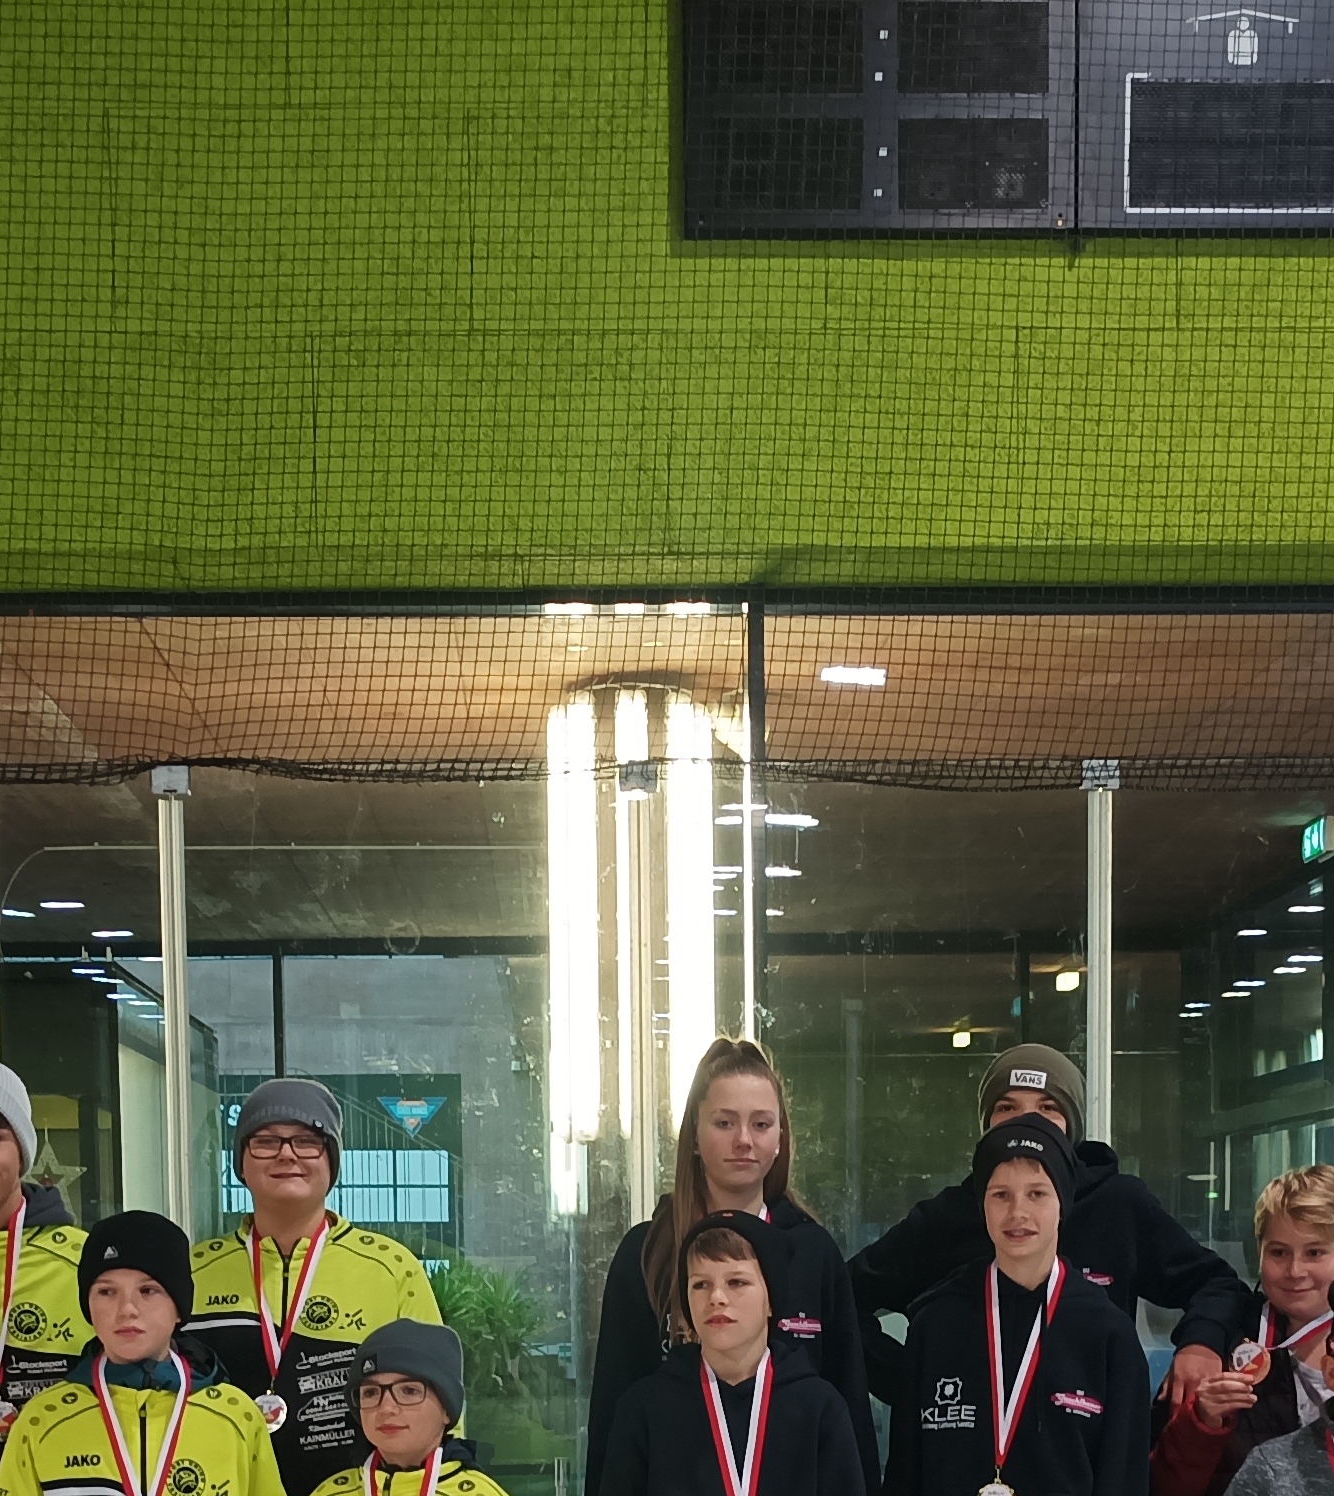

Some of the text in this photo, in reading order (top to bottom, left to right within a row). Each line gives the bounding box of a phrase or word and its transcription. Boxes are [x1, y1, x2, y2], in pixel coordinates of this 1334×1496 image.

[1014, 1072, 1043, 1085] VANS
[1020, 1140, 1044, 1152] JAKO
[206, 1294, 239, 1306] JAKO
[921, 1405, 976, 1422] KLEE
[64, 1454, 101, 1468] JAKO
